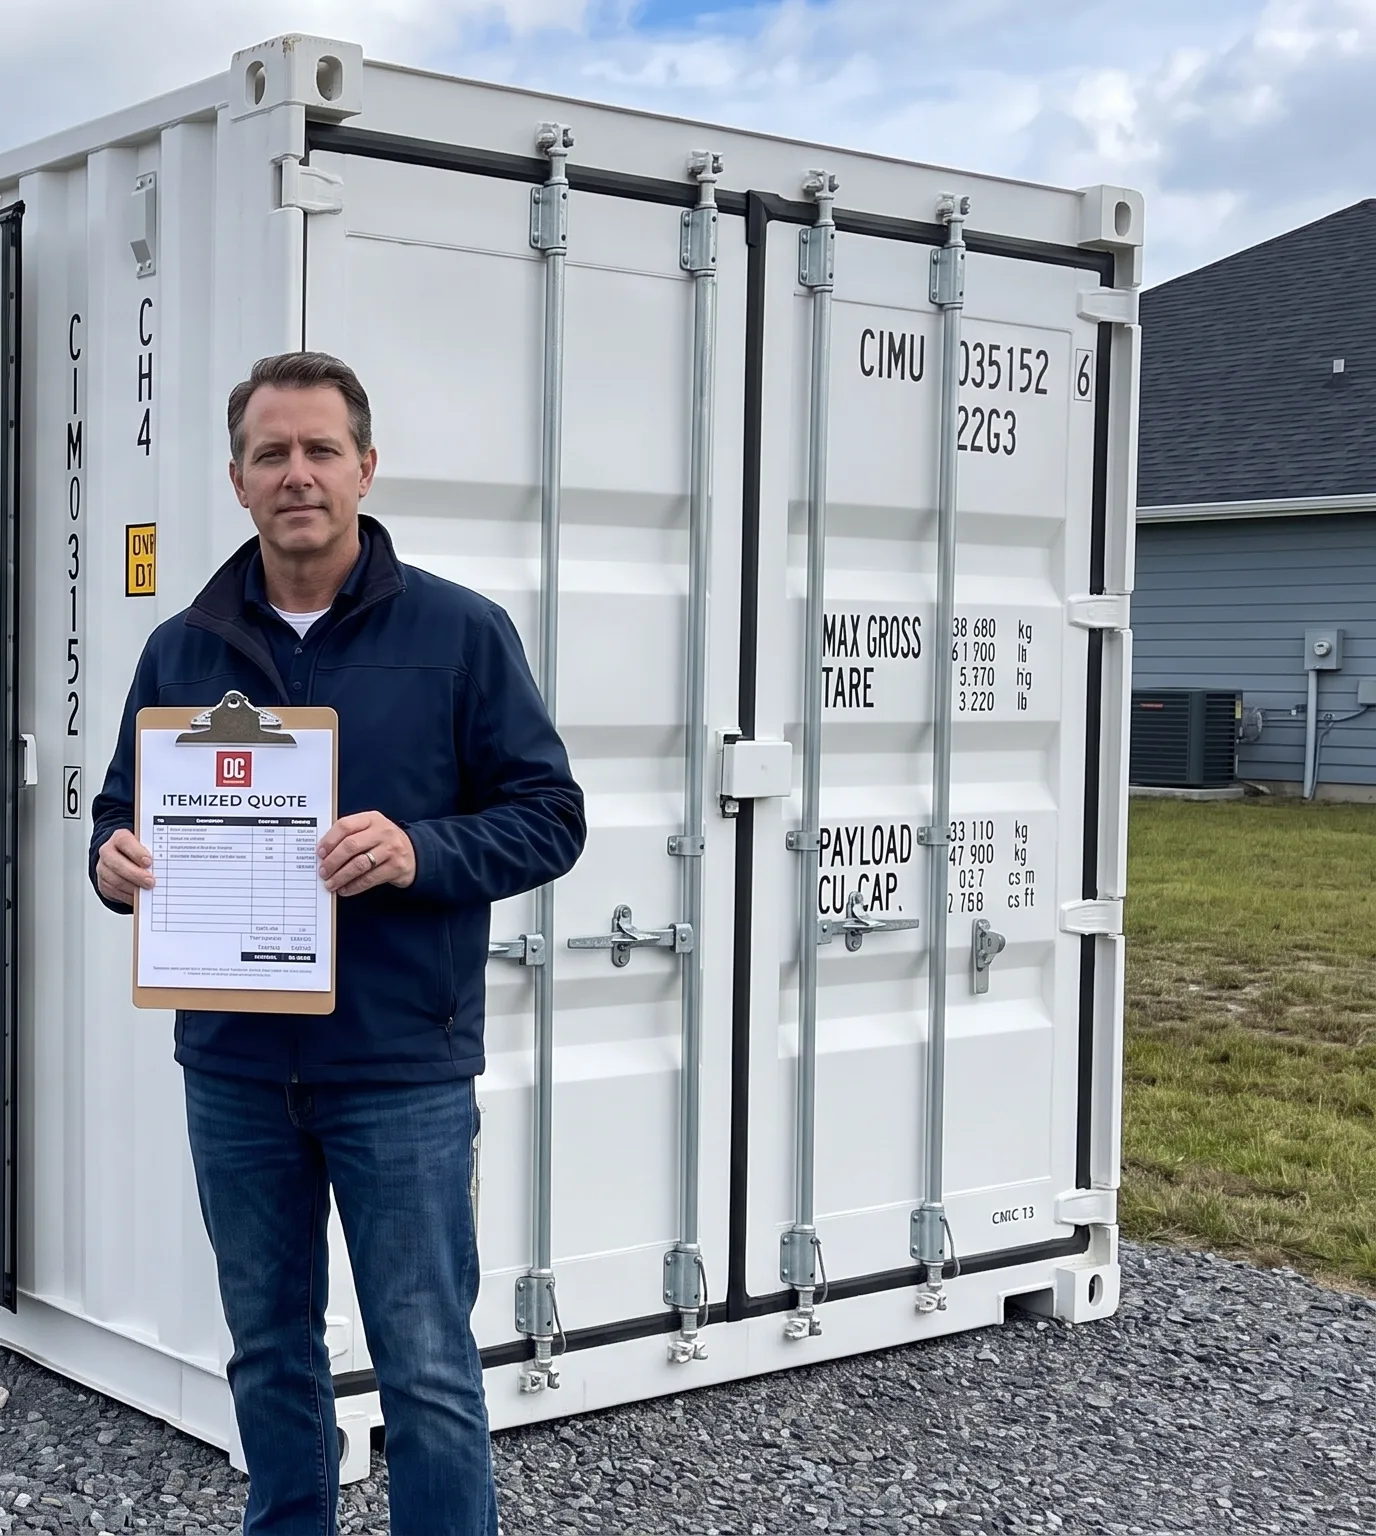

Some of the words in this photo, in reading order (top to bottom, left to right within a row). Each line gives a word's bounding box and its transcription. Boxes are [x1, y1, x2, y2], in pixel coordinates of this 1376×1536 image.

[860, 328, 925, 382] CIMU
[1077, 354, 1090, 397] 6
[957, 405, 1017, 455] 22G3
[823, 613, 861, 658] MAX
[867, 614, 922, 659] GROSS
[953, 617, 967, 637] 38
[973, 618, 996, 638] 680
[1018, 619, 1032, 644] kg
[822, 666, 875, 708] TARE
[1017, 691, 1027, 711] lb
[223, 757, 245, 779] OC
[67, 771, 78, 815] 6
[163, 794, 242, 807] ITEMIZED
[247, 794, 307, 809] QUOTE
[950, 821, 965, 842] 33
[972, 820, 994, 841] 110
[1015, 820, 1028, 844] kg
[819, 824, 912, 868] PAYLOAD
[949, 845, 964, 867] 47
[970, 843, 994, 865] 900
[1014, 843, 1027, 867] kg
[1025, 870, 1035, 884] m
[818, 874, 845, 915] CU
[1024, 887, 1035, 907] ft
